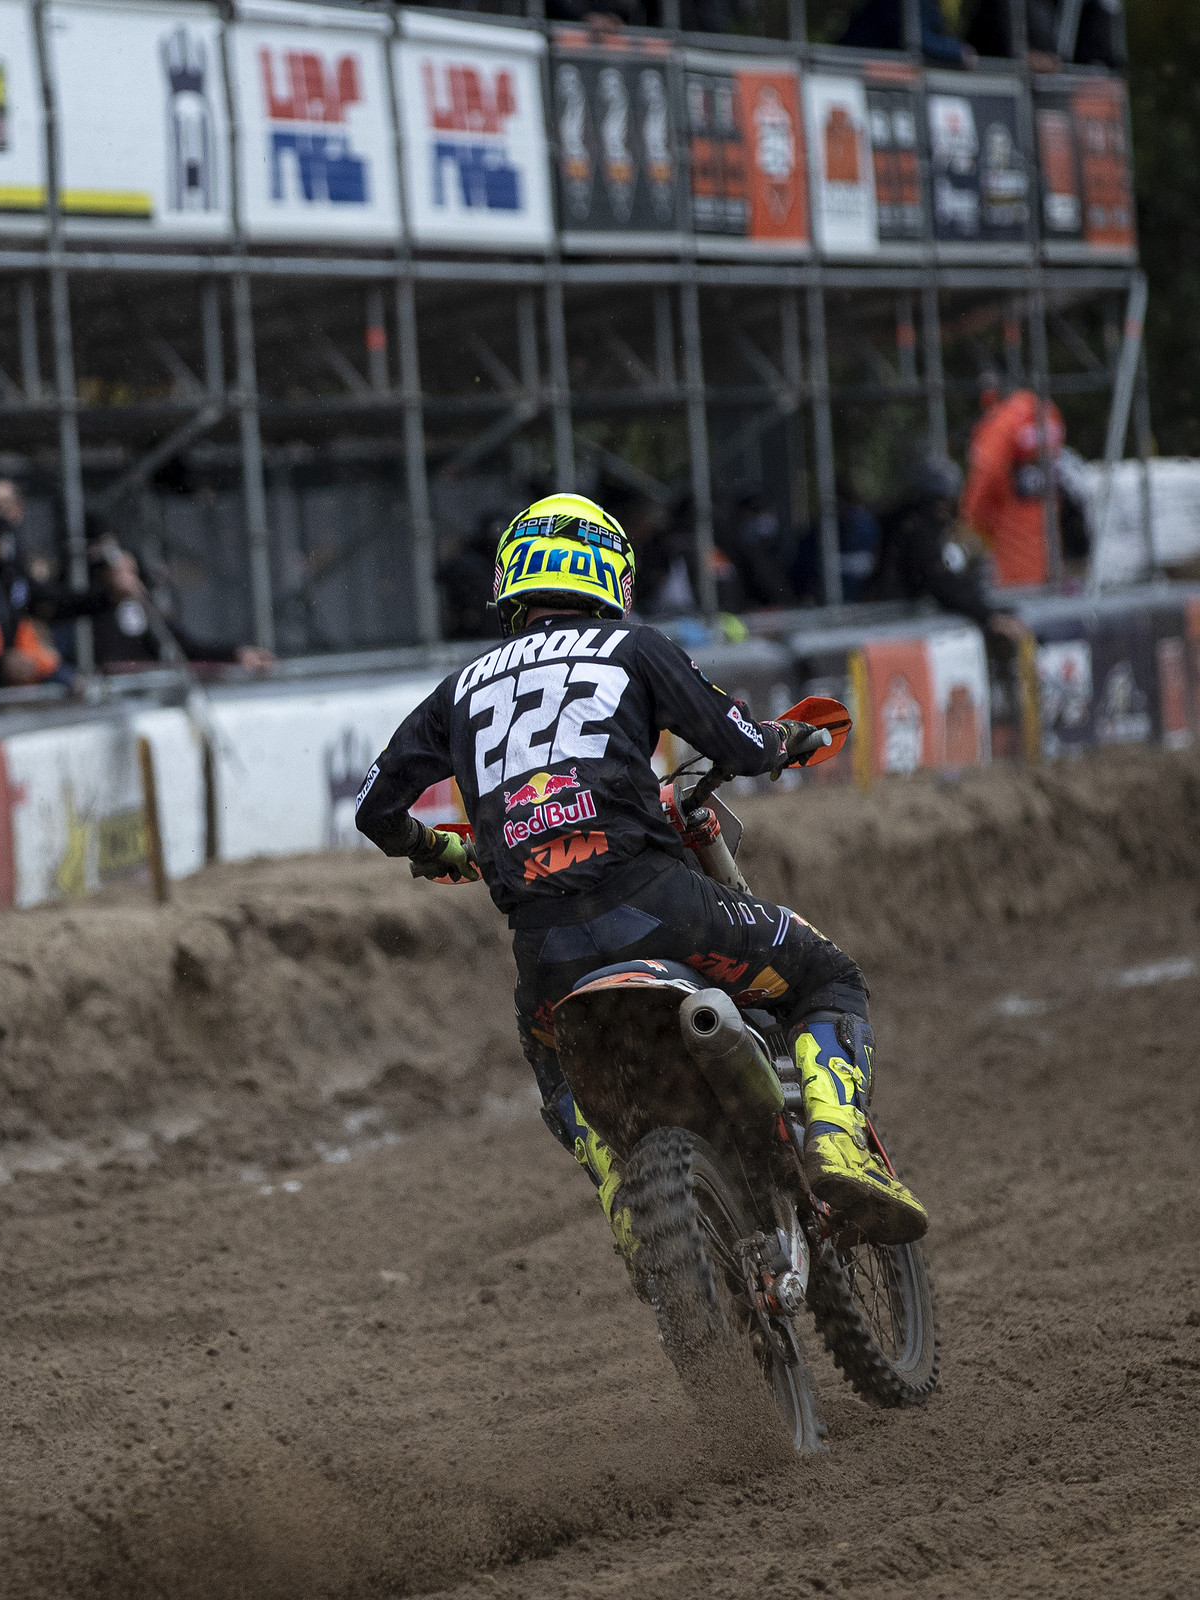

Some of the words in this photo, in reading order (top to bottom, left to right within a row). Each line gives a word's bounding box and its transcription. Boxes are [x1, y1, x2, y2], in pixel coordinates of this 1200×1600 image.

[579, 519, 622, 543] GoPro
[501, 538, 622, 609] Airoh
[454, 628, 630, 706] CAIROLI
[469, 662, 630, 798] 222
[503, 805, 548, 849] Red
[543, 789, 598, 829] Bull
[523, 830, 609, 885] KTM
